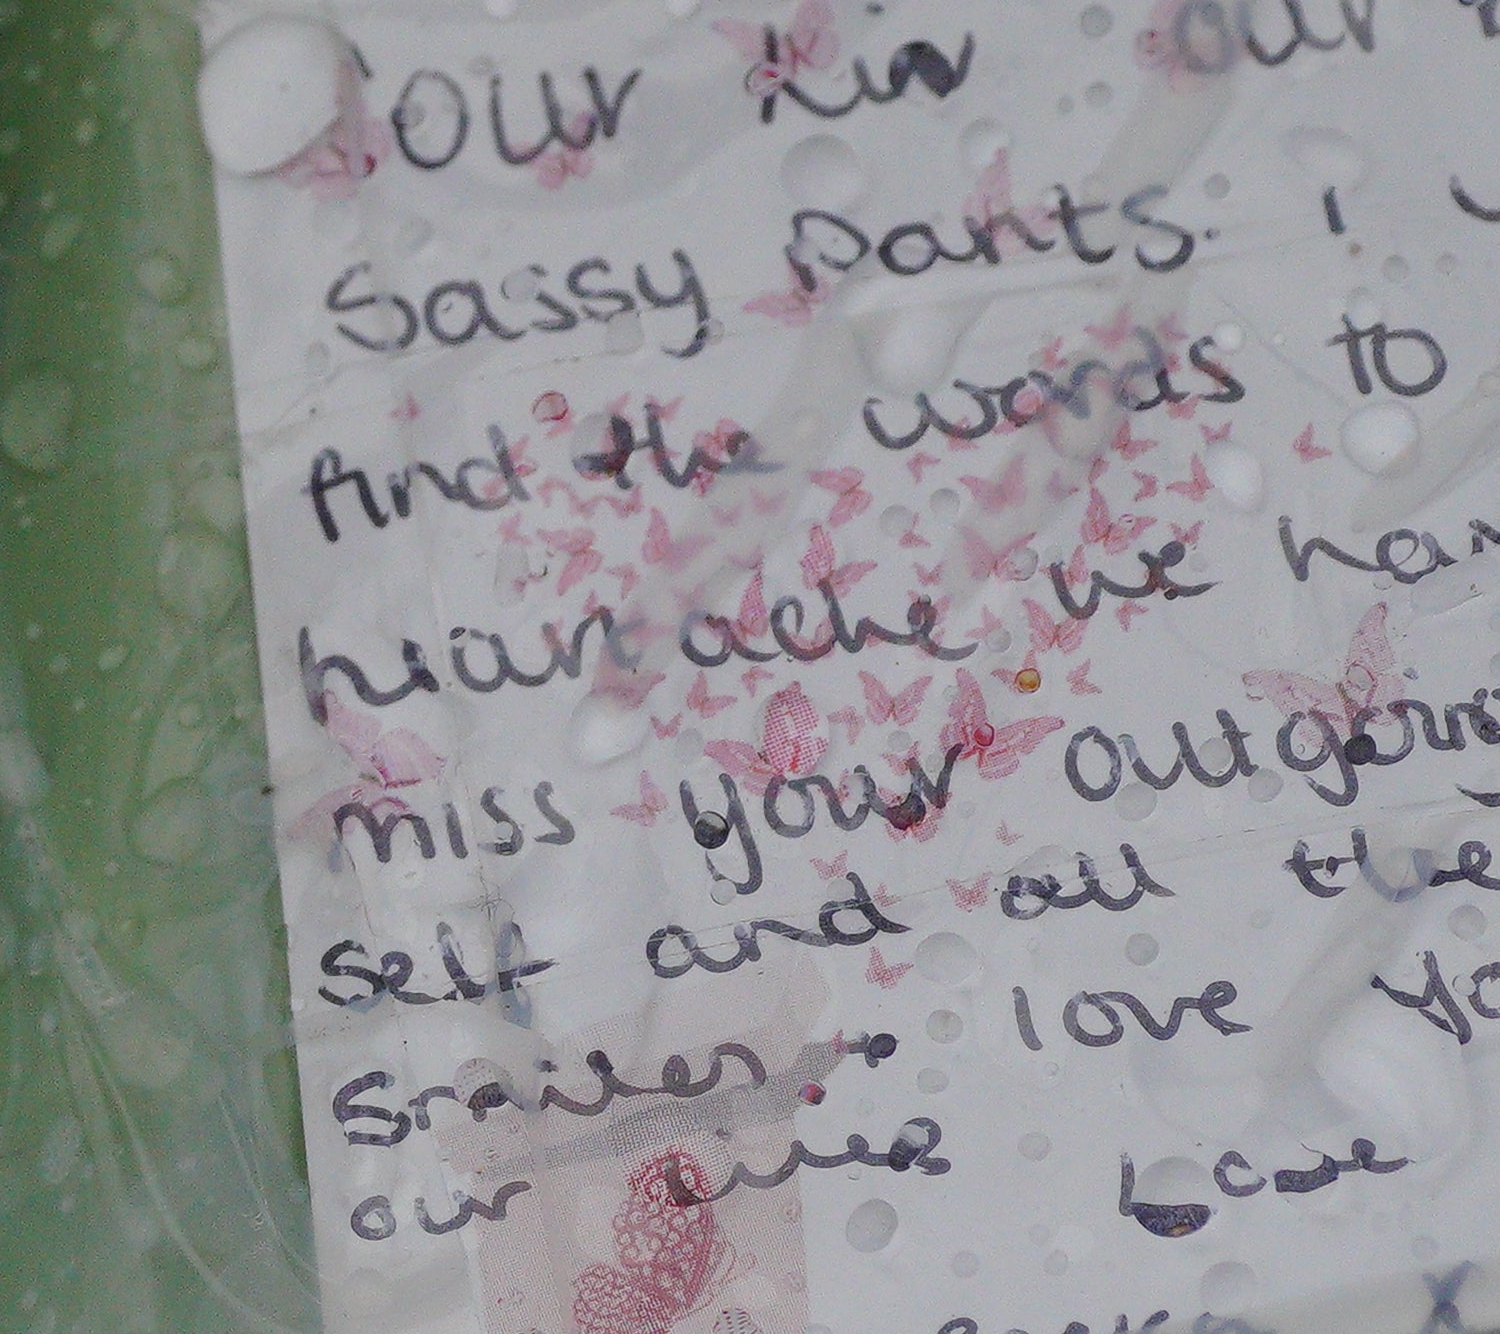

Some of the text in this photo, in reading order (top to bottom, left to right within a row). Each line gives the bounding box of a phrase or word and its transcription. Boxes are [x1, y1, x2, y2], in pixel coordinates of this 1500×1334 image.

[862, 323, 1246, 452] words
[1327, 311, 1447, 396] to
[334, 781, 577, 863] miss
[679, 742, 967, 896] your
[645, 871, 913, 980] and
[999, 842, 1177, 920] all
[1012, 979, 1255, 1052] love
[349, 1179, 534, 1242] our
